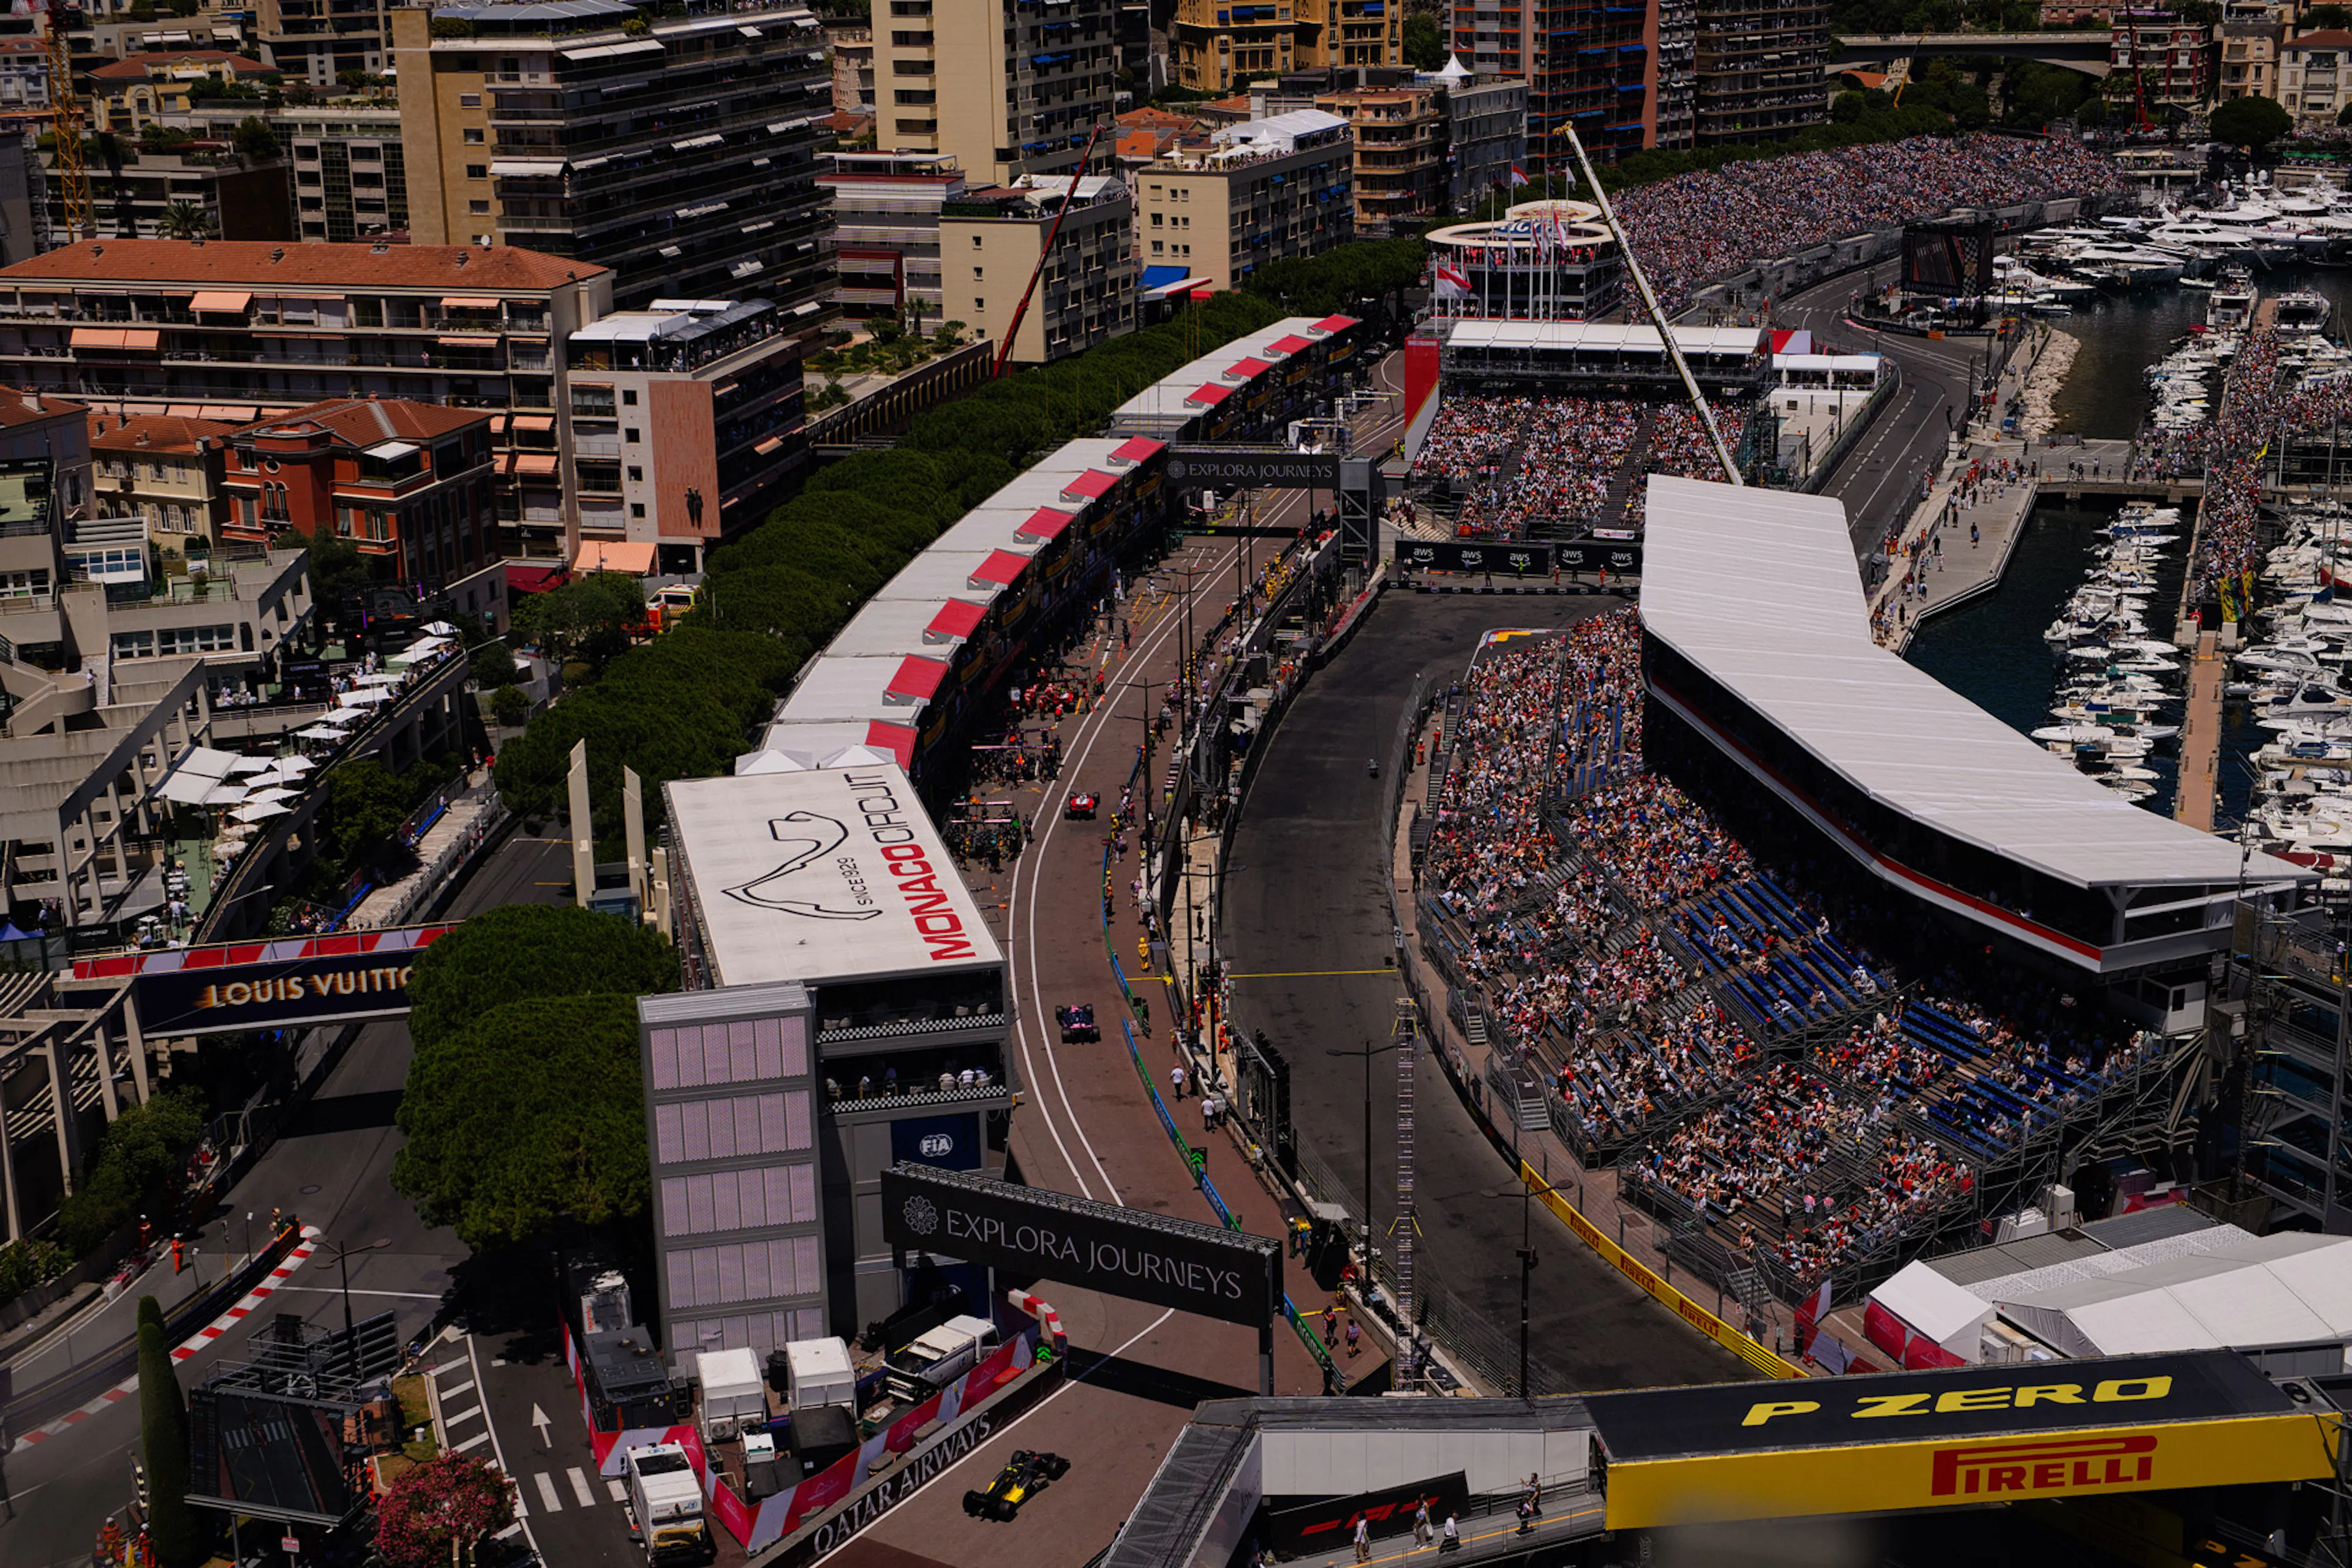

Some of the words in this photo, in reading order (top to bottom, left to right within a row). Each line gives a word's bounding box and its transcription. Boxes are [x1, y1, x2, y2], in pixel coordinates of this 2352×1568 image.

[1188, 463, 1256, 477] EXPLORA
[1258, 464, 1333, 479] JOURNEYS
[1413, 547, 1434, 558] aws
[1461, 549, 1482, 560] aws
[1509, 552, 1531, 562] aws
[1562, 549, 1583, 559] aws
[1611, 551, 1632, 562] aws
[843, 773, 914, 843] CIRCUIT
[880, 843, 976, 961] MONACO
[206, 976, 306, 1009] LOUIS
[1570, 1212, 1600, 1249] PIRELLI
[946, 1209, 1080, 1264] EXPLORA
[1086, 1240, 1242, 1300] JOURNEYS
[1621, 1255, 1655, 1294] PIRELLI
[1679, 1297, 1719, 1338] PIRELLI
[1741, 1400, 1821, 1427] P
[1850, 1375, 2173, 1419] ZERO
[813, 1480, 897, 1555] QATAR
[899, 1411, 992, 1498] AIRWAYS
[1931, 1434, 2157, 1496] PIRELLI
